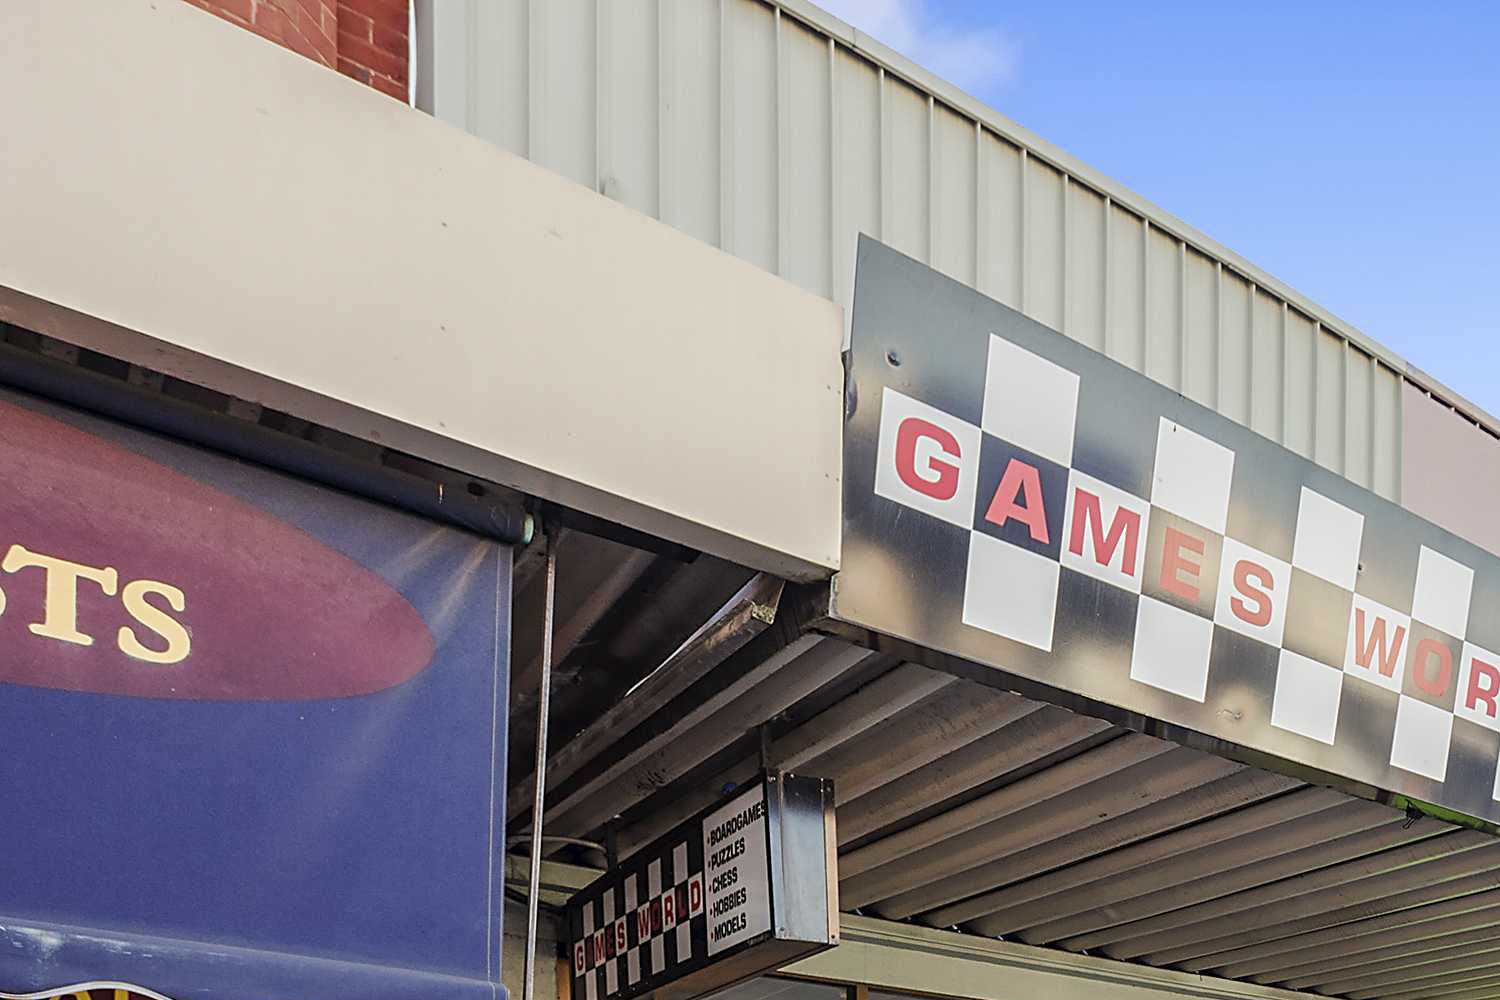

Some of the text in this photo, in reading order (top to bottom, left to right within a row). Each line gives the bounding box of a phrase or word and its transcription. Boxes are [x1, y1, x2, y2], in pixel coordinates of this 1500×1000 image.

[895, 417, 1273, 627] GAMES
[0, 544, 191, 664] TS
[711, 800, 766, 847] BOARDGAMES
[711, 837, 746, 870] PUZZLES
[712, 866, 738, 893] CHESS
[713, 887, 747, 918] HOBBIES
[577, 880, 701, 971] GAMES WORLD
[714, 912, 747, 942] MODELS
